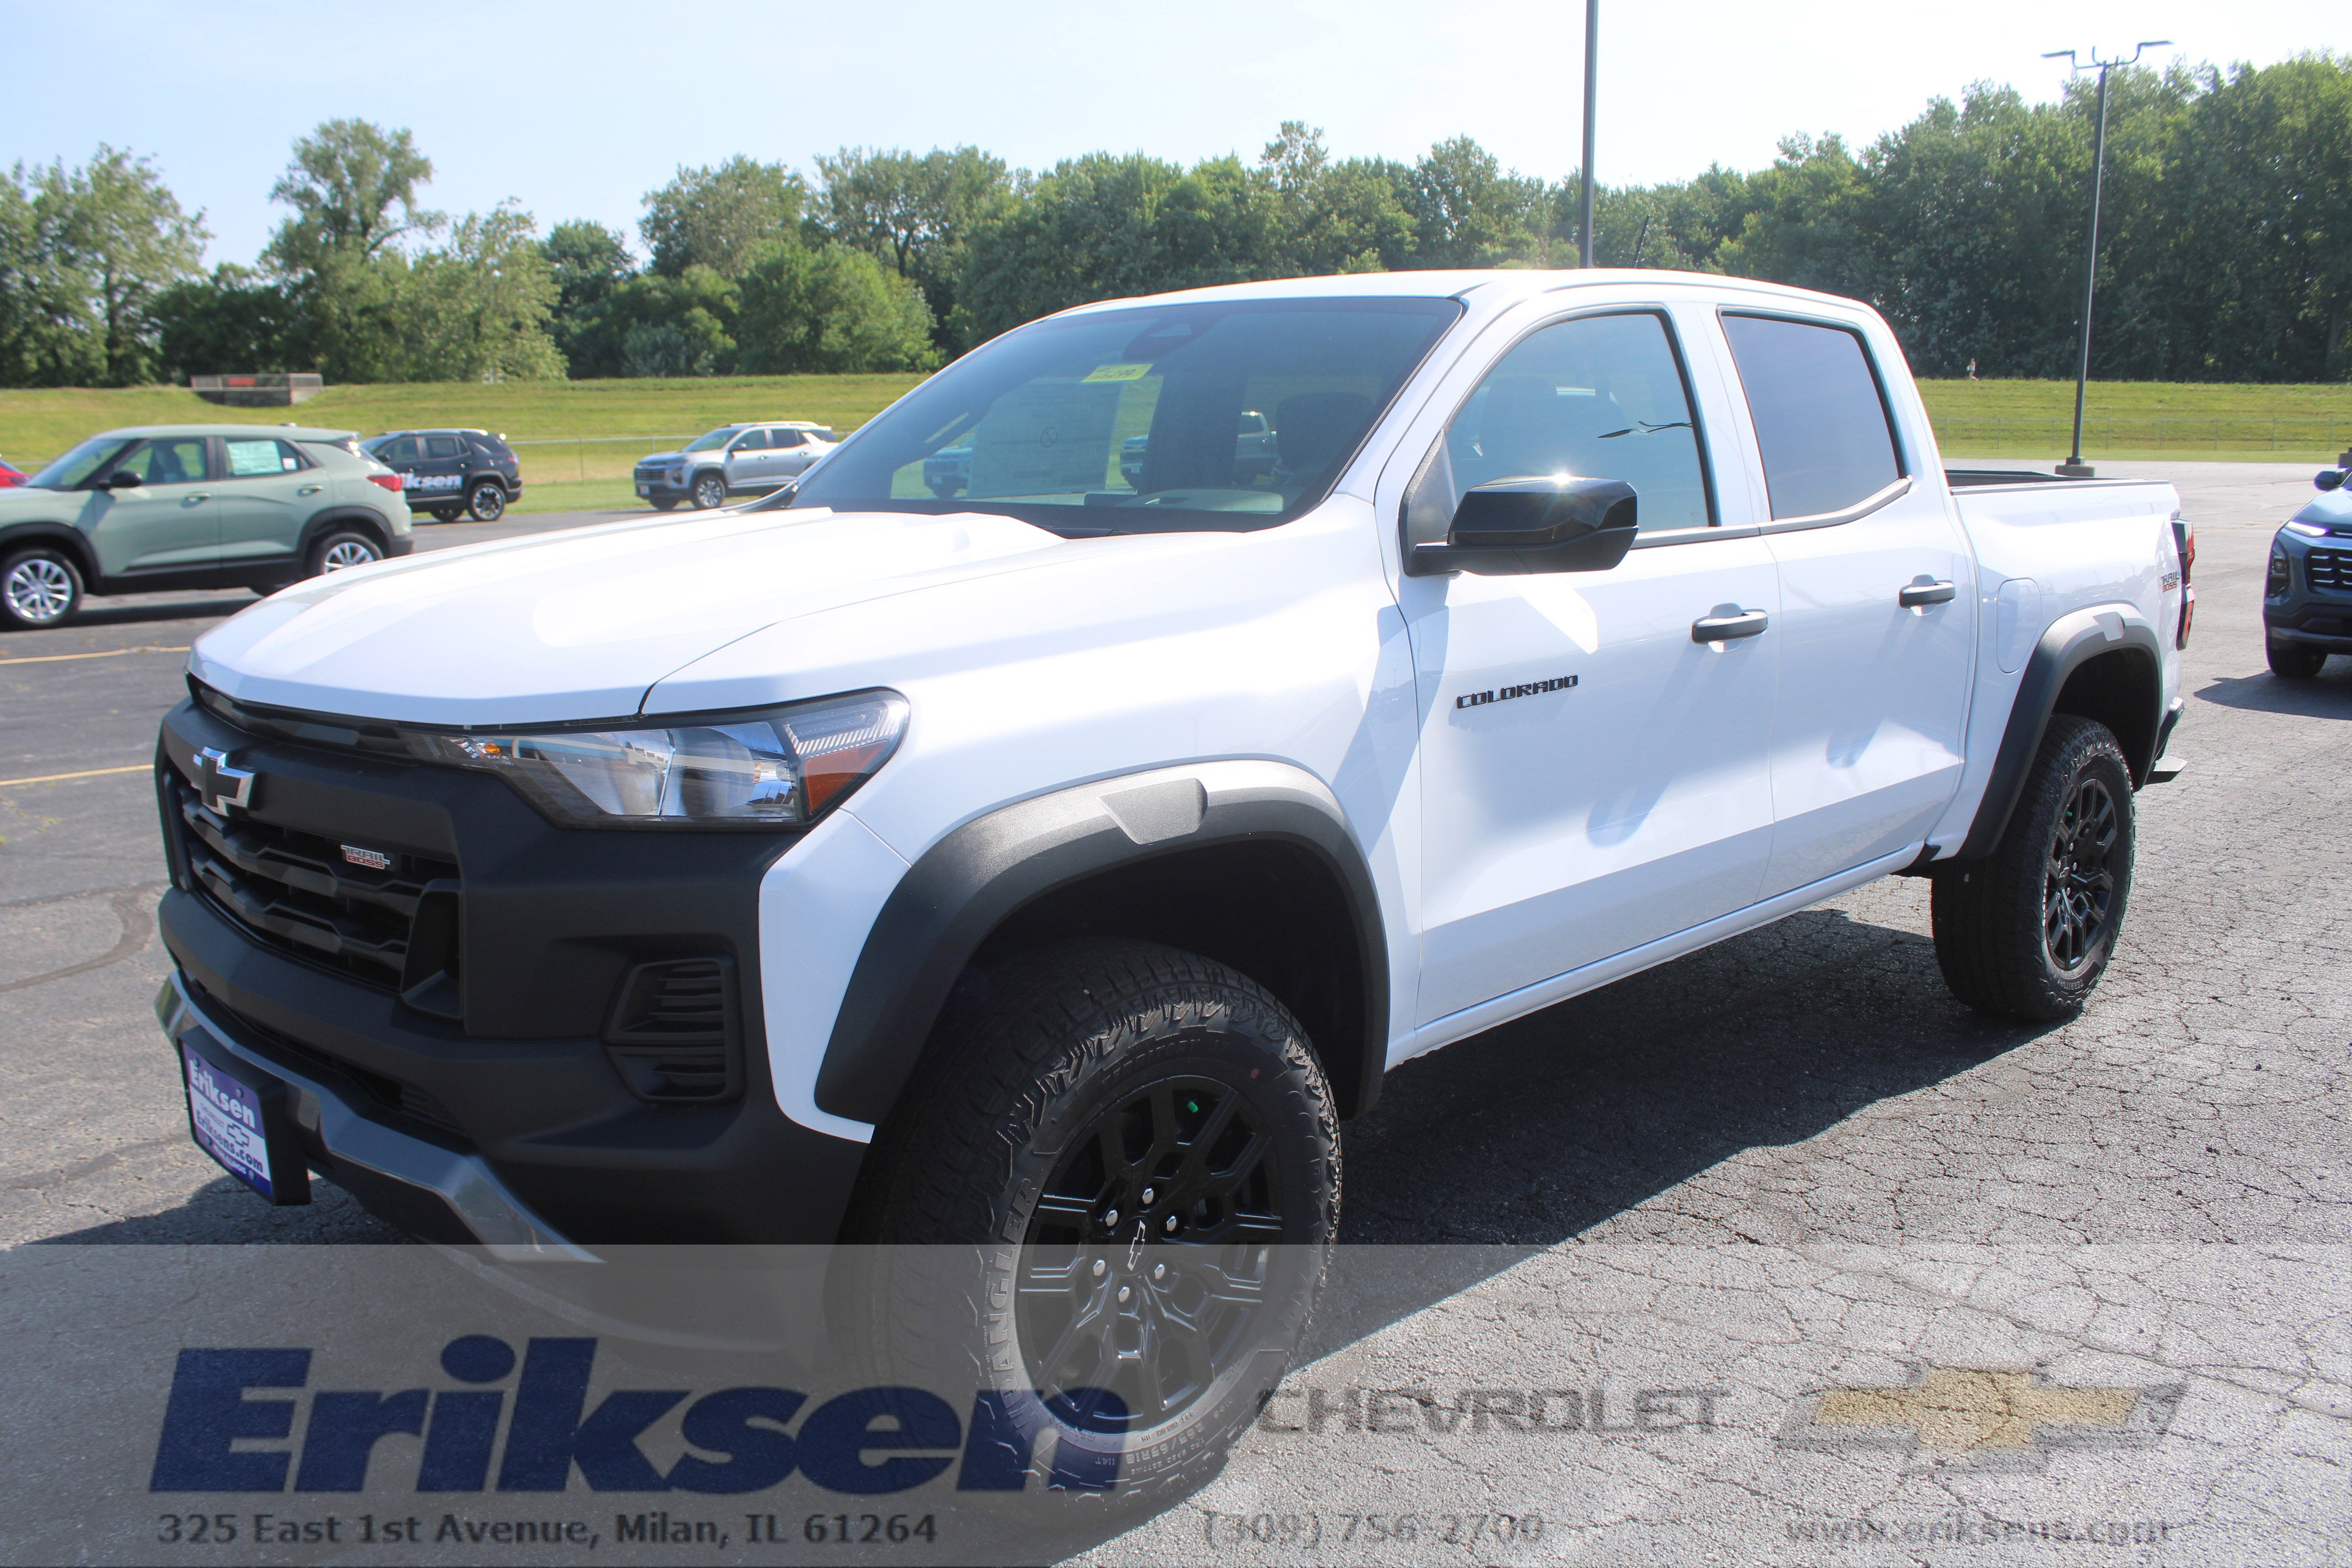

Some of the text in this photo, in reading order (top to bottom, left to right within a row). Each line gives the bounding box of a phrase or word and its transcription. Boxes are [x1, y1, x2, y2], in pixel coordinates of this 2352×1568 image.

[401, 472, 462, 489] iksen
[2161, 572, 2180, 584] TRAIL
[2163, 581, 2177, 592] BOSS
[1457, 675, 1578, 708] COLORADO
[341, 845, 390, 864] TRAIL
[347, 855, 384, 869] BOSS
[189, 1060, 255, 1128] Eriksen
[196, 1109, 263, 1172] Eriksens.com
[1126, 1421, 1204, 1464] 265/65R18
[1095, 1457, 1115, 1466] 114T
